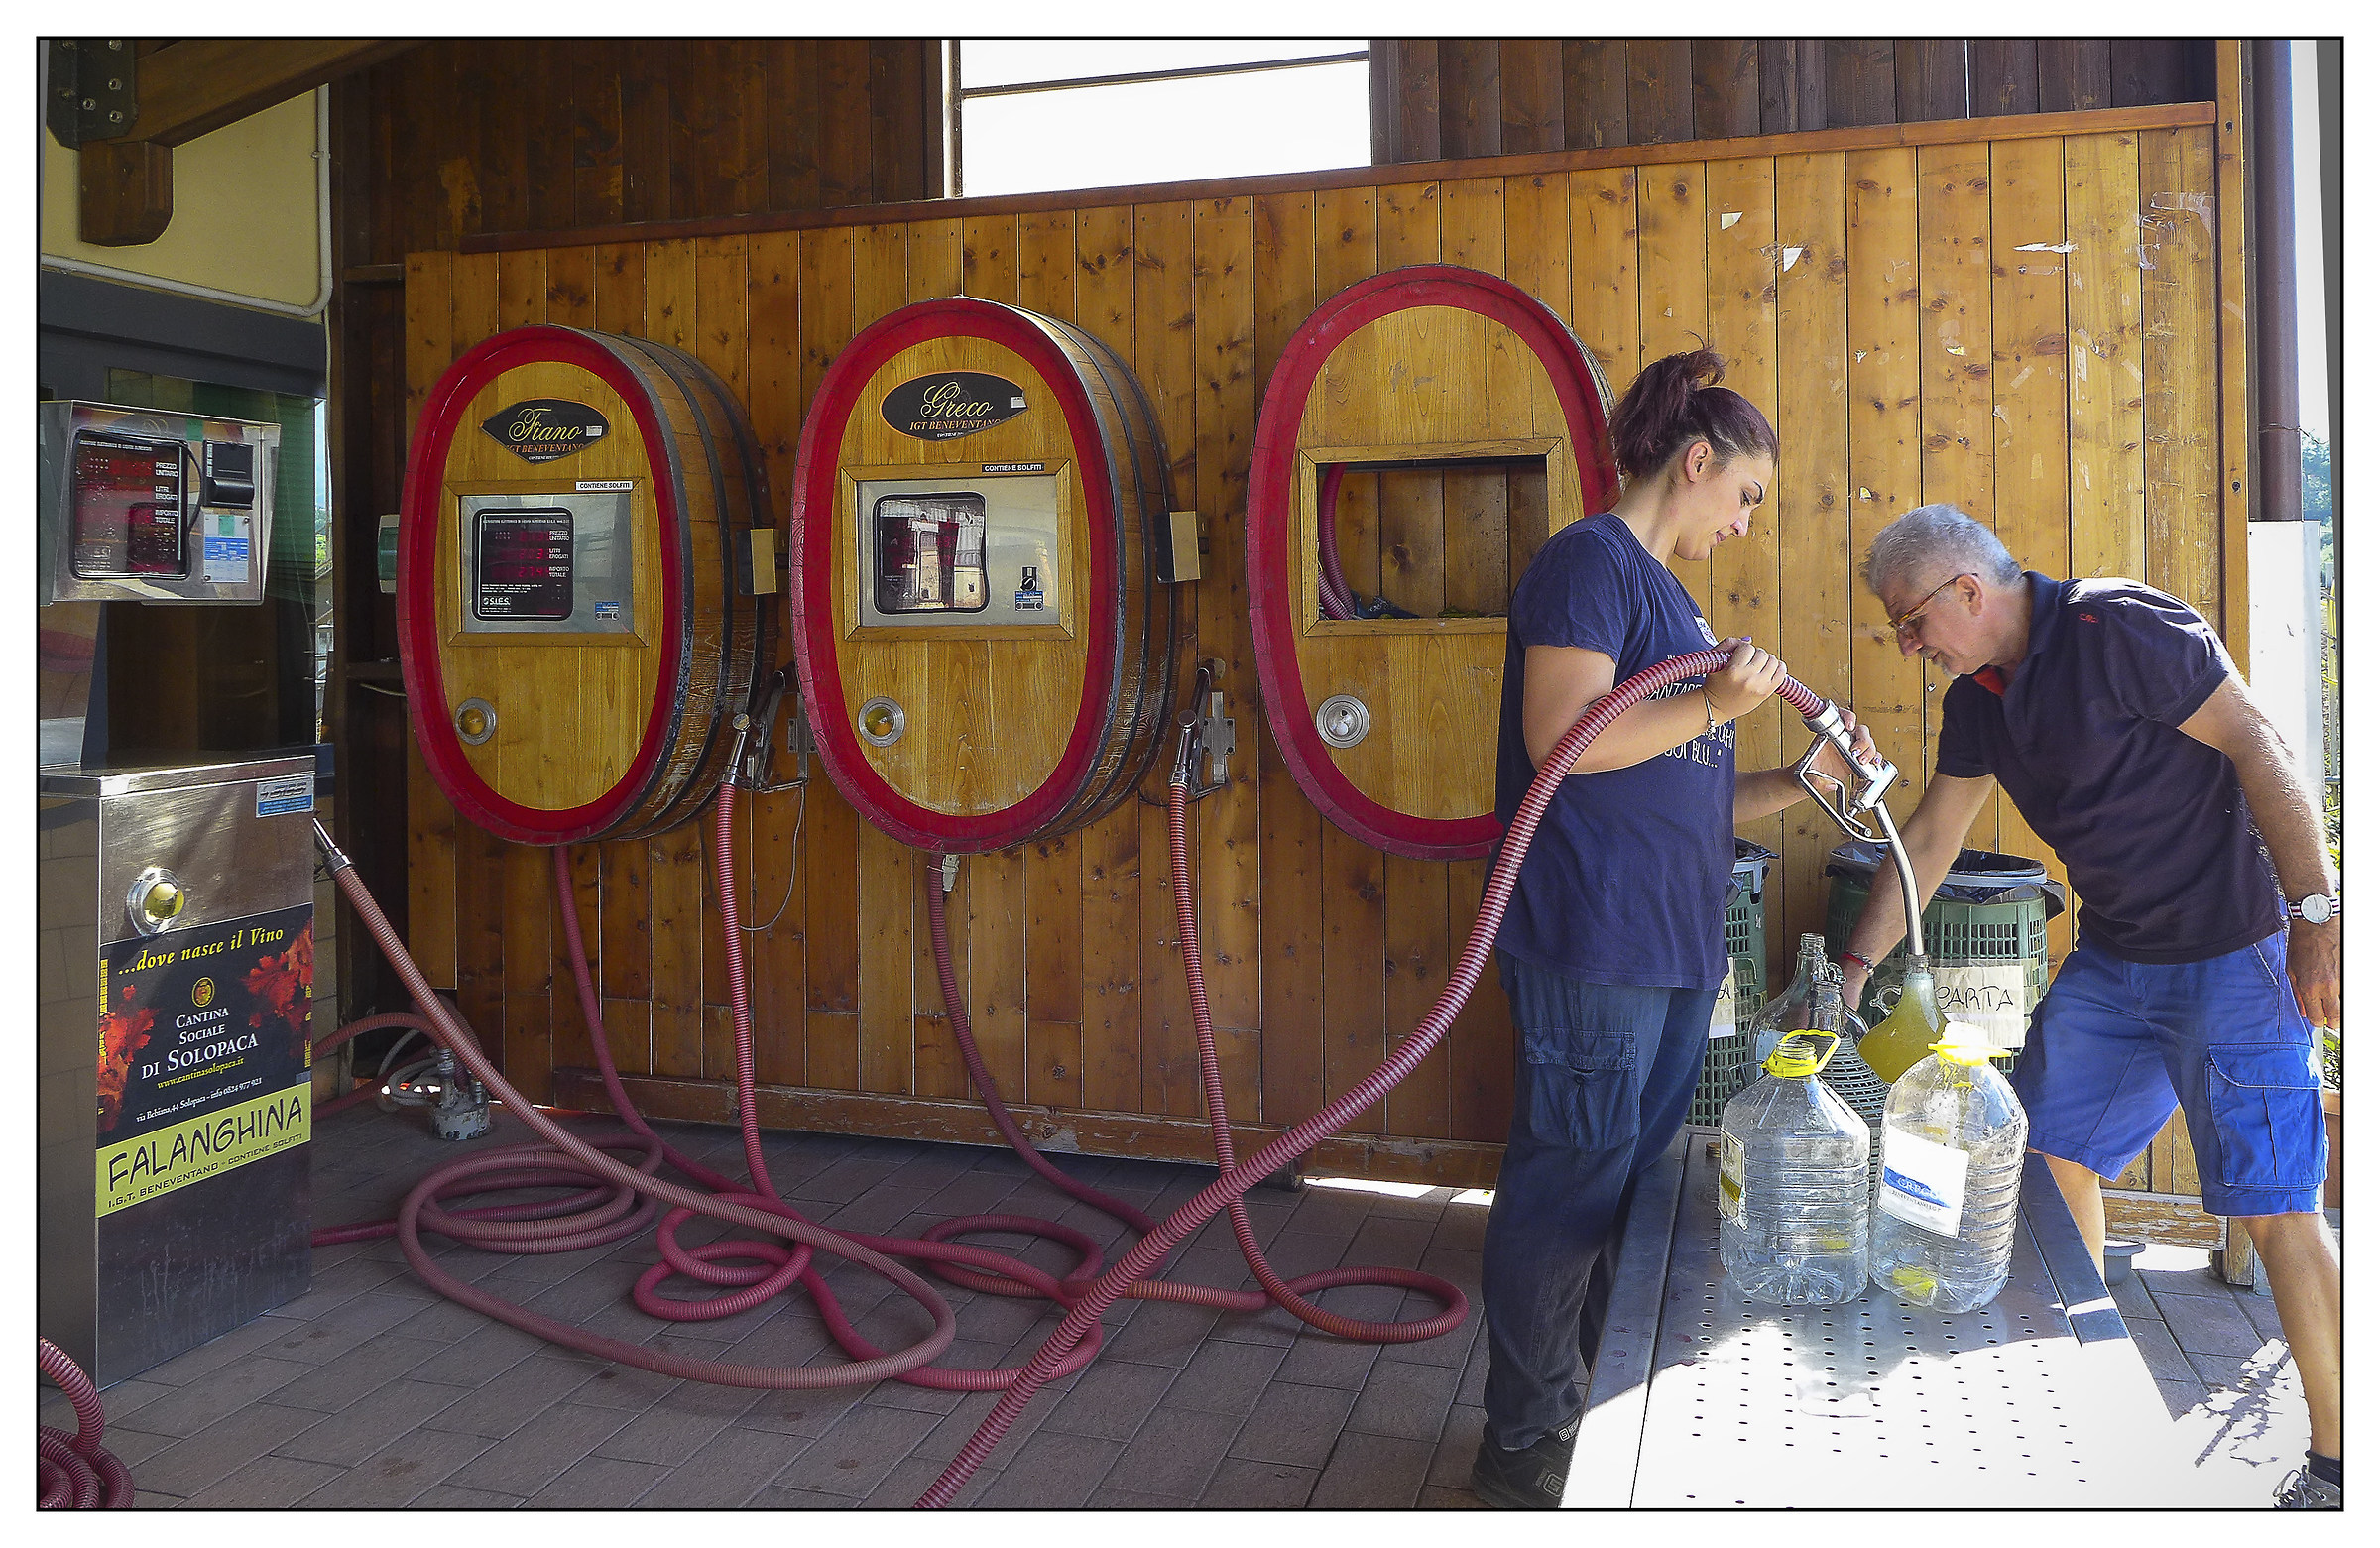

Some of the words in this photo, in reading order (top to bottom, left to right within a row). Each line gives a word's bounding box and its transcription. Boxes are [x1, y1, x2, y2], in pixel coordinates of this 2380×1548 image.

[919, 381, 994, 418] Greco
[508, 408, 583, 442] Fiano
[909, 421, 928, 431] IGT
[118, 949, 175, 976] ...dove
[180, 941, 224, 961] nasce
[230, 930, 244, 950] il
[250, 927, 284, 946] Vino
[141, 1061, 160, 1080] DI
[167, 1032, 260, 1072] SOLOPACA
[157, 1056, 245, 1089] www.cantinasolopaca.it
[108, 1095, 302, 1193] FALANGHINA
[108, 1192, 136, 1208] I.G.T.
[139, 1161, 219, 1197] BENEVENTANO
[227, 1143, 271, 1165] CONTIENE
[272, 1132, 302, 1149] SOLFITI
